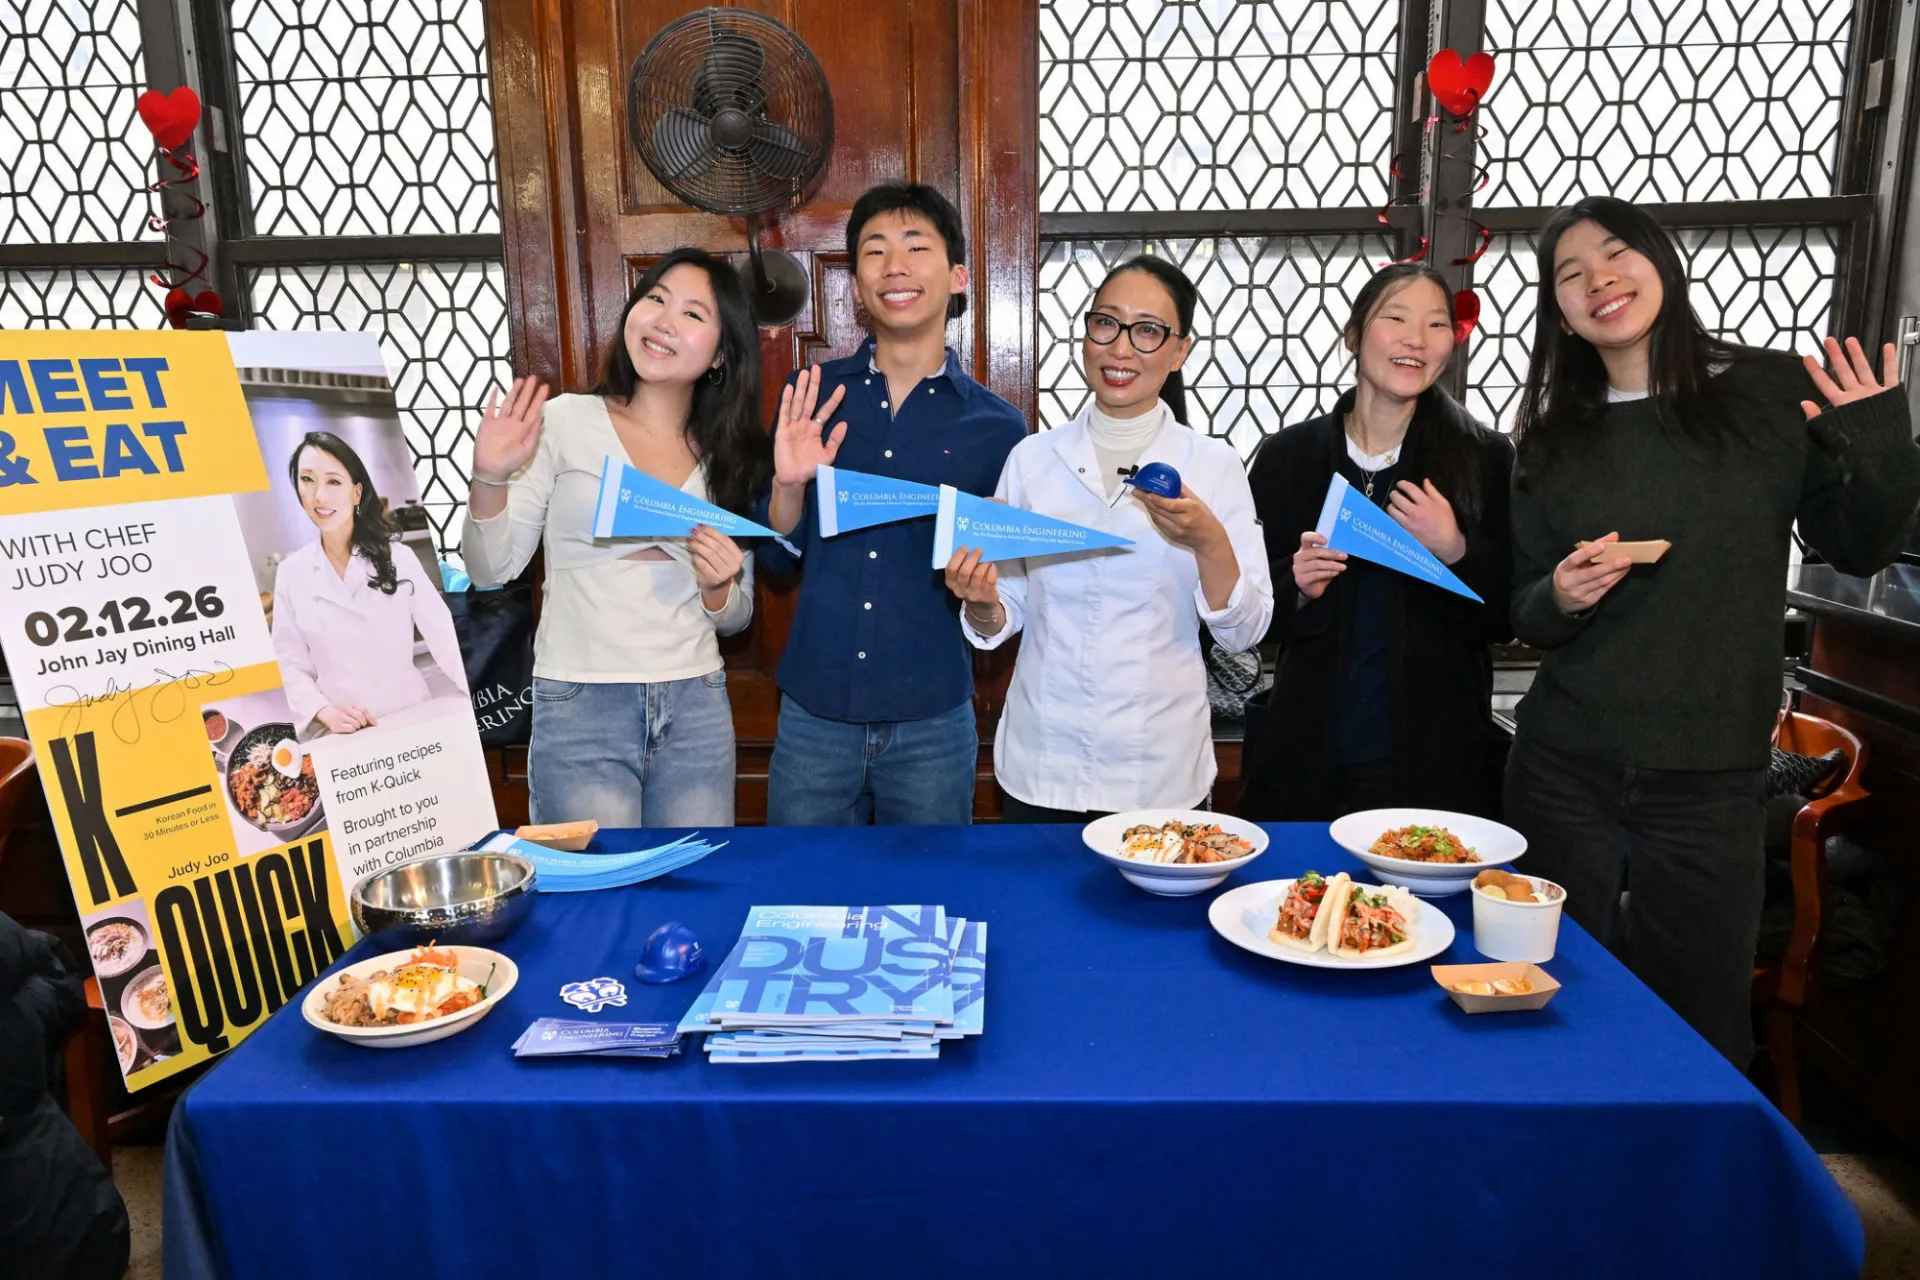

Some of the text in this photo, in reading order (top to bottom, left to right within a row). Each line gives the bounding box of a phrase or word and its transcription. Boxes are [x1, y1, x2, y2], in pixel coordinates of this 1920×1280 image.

[43, 420, 188, 482] EAT
[633, 495, 676, 511] COLUMBIA
[679, 505, 737, 524] ENGINEERING
[852, 492, 896, 501] COLUMBIA
[0, 523, 157, 560] WITH CHEF
[972, 521, 1020, 535] COLUMBIA
[1023, 525, 1087, 539] ENGINEERING
[1352, 516, 1391, 544] COLUMBIA
[1392, 539, 1443, 575] ENGINEERING
[12, 553, 152, 590] JUDY JOO
[24, 585, 225, 647] 02.12.26
[37, 625, 236, 676] John Jay Dining Hall
[331, 742, 443, 783] Featuring recipes
[336, 768, 422, 804] from K-Quick
[143, 813, 219, 841] 30 Minutes or Less
[156, 801, 217, 824] Korean Food in
[343, 795, 439, 834] Brought to you
[348, 817, 437, 855] in partnership
[168, 852, 229, 879] Judy Joo
[353, 835, 444, 876] with Columbia
[154, 838, 345, 1055] QUICK
